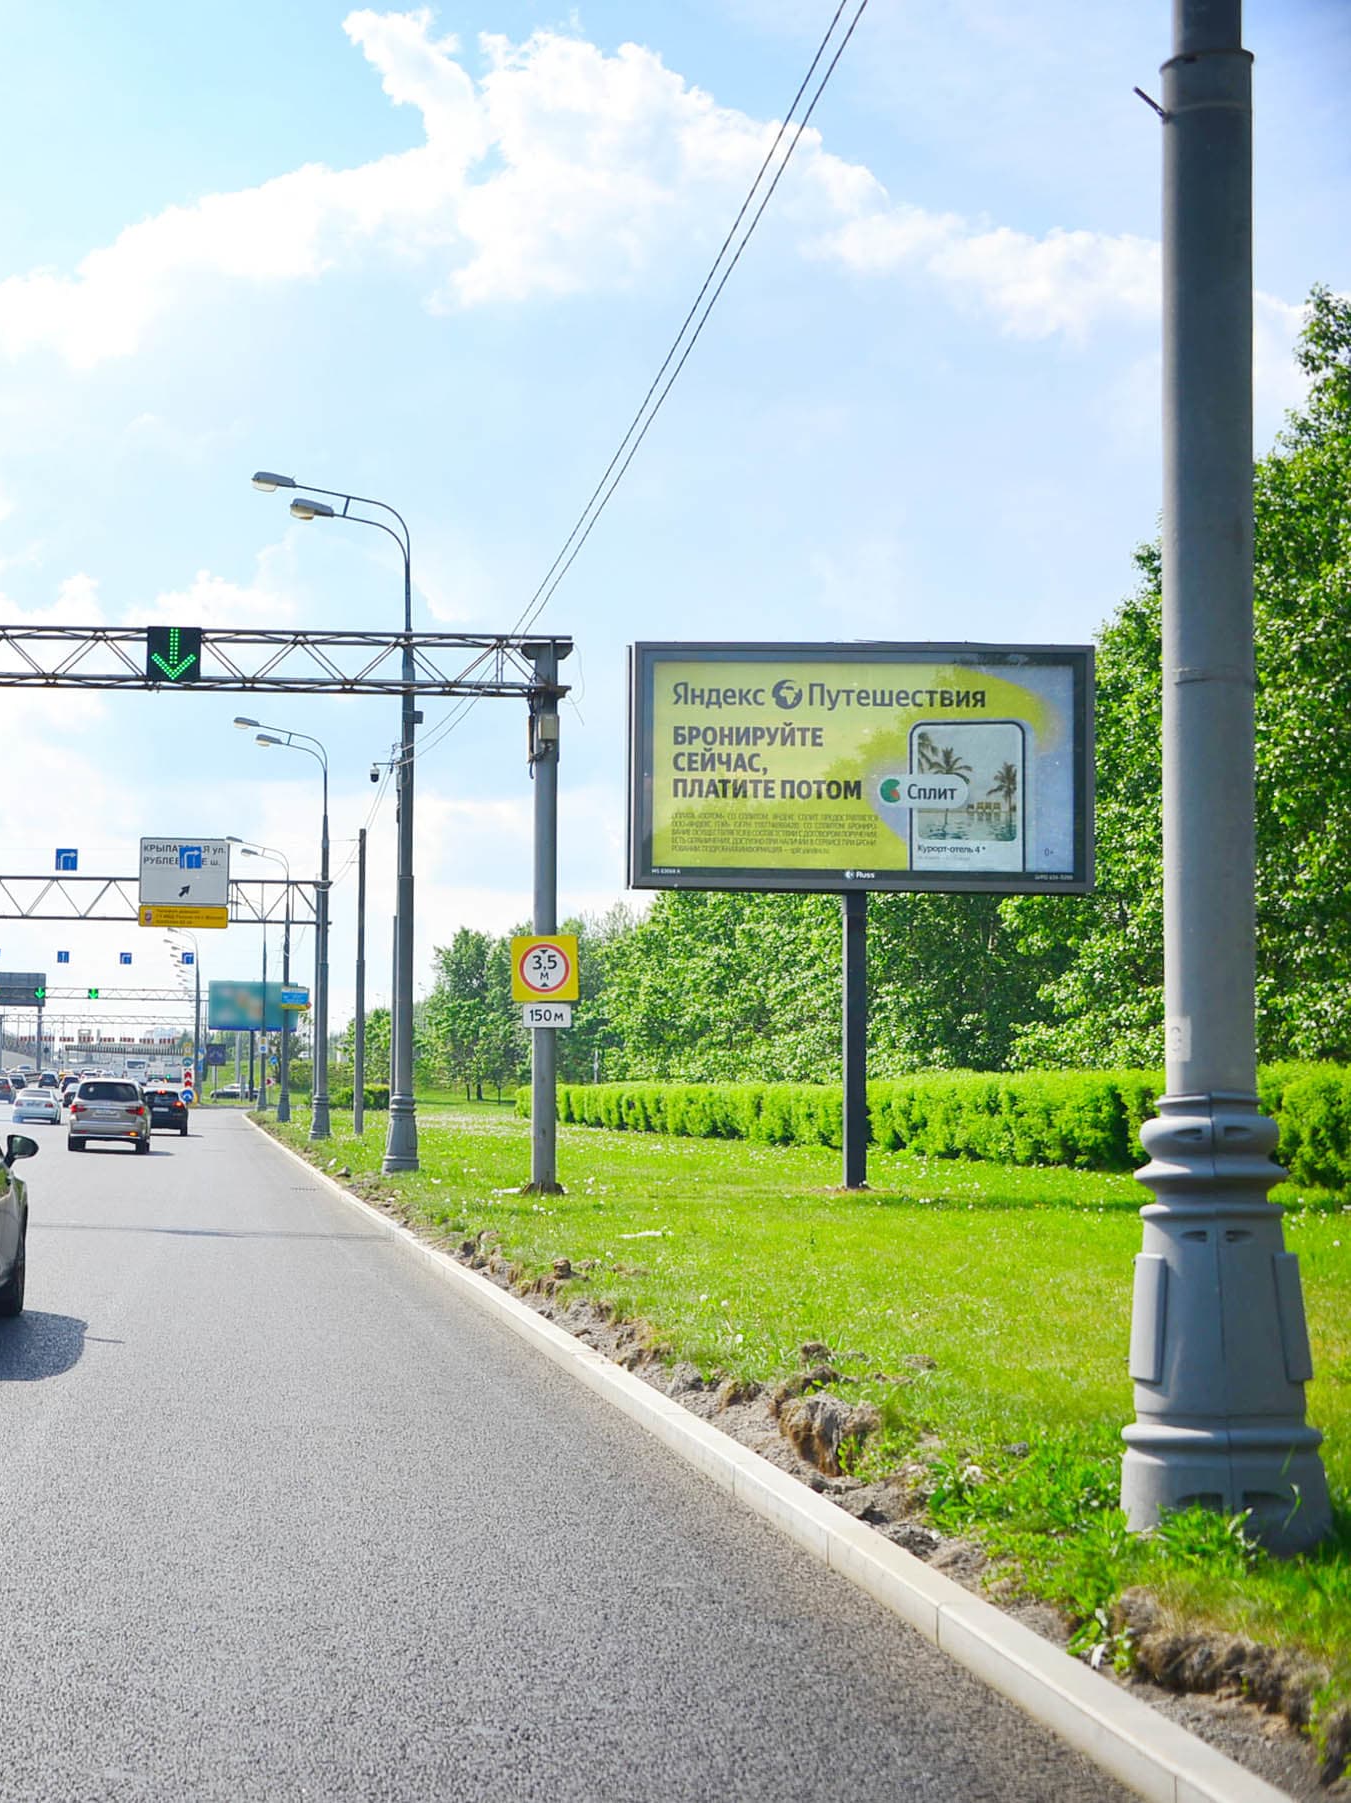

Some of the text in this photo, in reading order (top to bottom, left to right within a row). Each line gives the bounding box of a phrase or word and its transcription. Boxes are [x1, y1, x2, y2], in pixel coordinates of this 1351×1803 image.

[672, 681, 986, 711] Яндекс Путешествия
[673, 722, 824, 747] БРОНИРУЙТЕ
[672, 747, 768, 775] СЕЙЧАС,
[672, 778, 862, 800] ПЛАТИТЕ ПОТОМ
[907, 783, 958, 801] Сплит
[532, 955, 557, 972] 3,5
